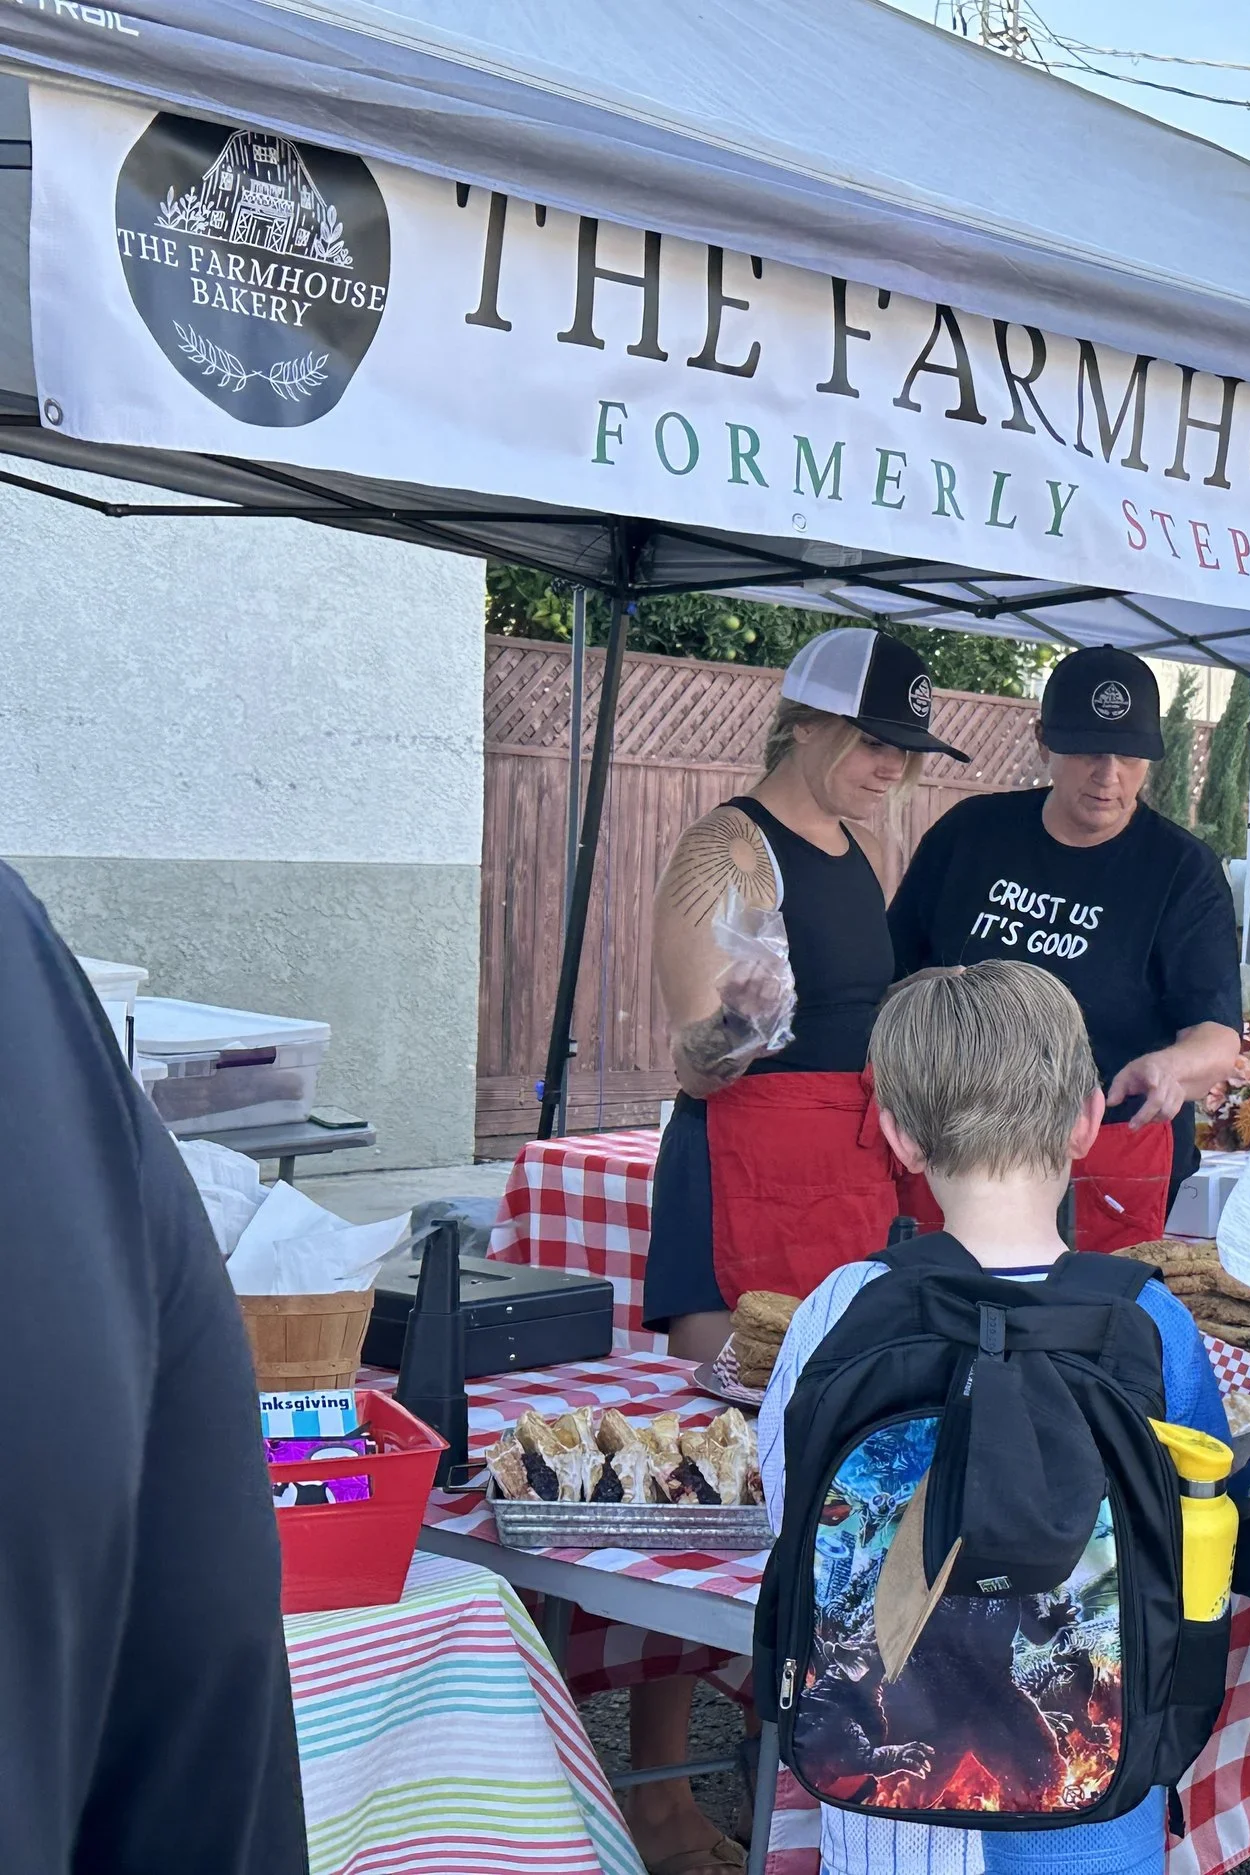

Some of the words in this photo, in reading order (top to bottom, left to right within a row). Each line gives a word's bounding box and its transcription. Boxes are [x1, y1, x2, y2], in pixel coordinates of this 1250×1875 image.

[117, 228, 179, 267] THE
[188, 244, 387, 312] FARMHOUSE
[455, 181, 764, 379] THE
[190, 277, 312, 327] BAKERY
[591, 400, 1079, 538] FORMERLY
[988, 878, 1066, 924] CRUST
[1069, 903, 1104, 930] US
[970, 912, 1024, 946] IT'S
[1027, 930, 1088, 960] GOOD
[261, 1395, 350, 1412] nksgiving
